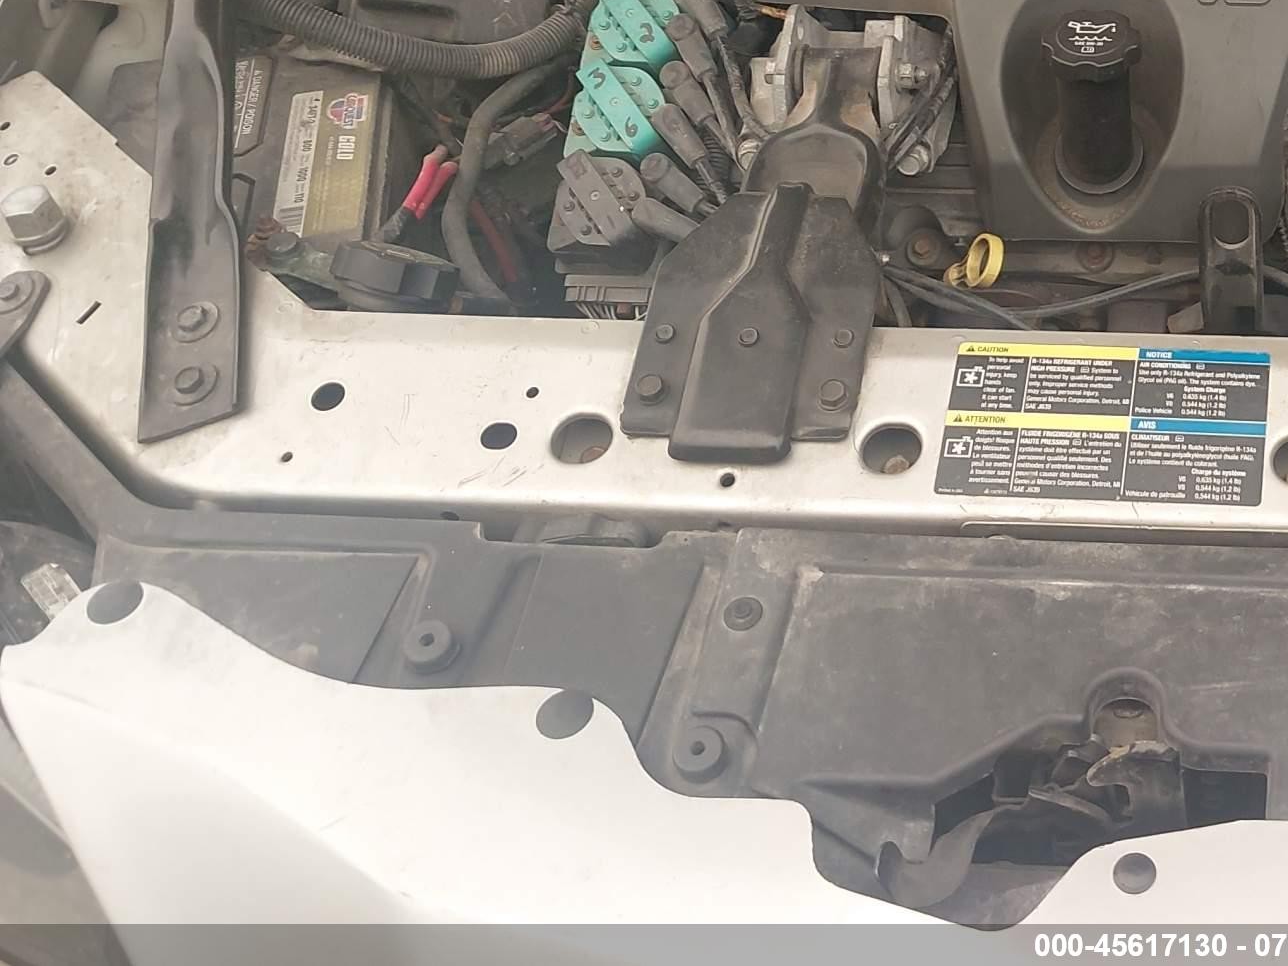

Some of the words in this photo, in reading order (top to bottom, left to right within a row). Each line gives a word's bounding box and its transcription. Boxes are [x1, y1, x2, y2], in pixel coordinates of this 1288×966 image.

[242, 108, 255, 135] POISON
[625, 117, 638, 138] 6
[336, 135, 356, 160] GOLD
